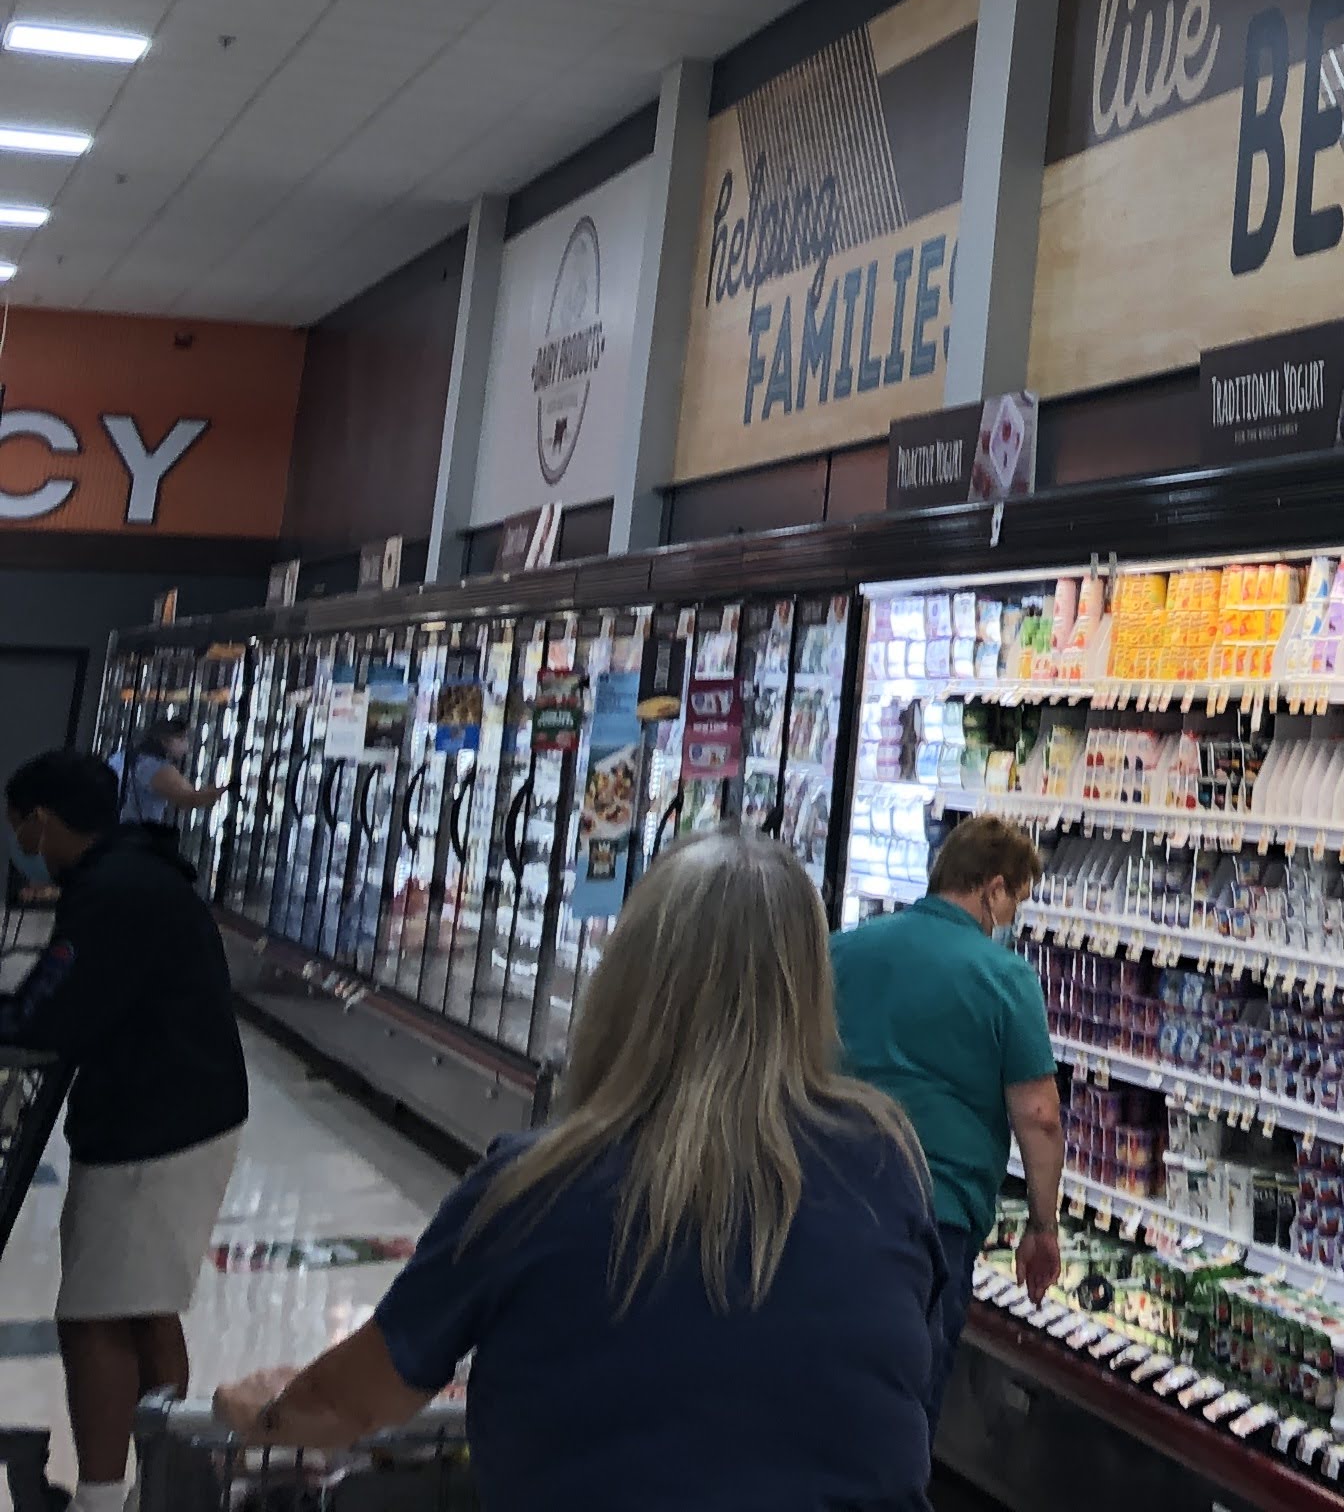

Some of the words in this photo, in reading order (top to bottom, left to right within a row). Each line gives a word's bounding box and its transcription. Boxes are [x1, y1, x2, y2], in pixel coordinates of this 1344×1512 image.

[706, 153, 841, 322] helping
[1212, 369, 1281, 428] TRADITIONAL
[1284, 360, 1324, 415] YOGURT
